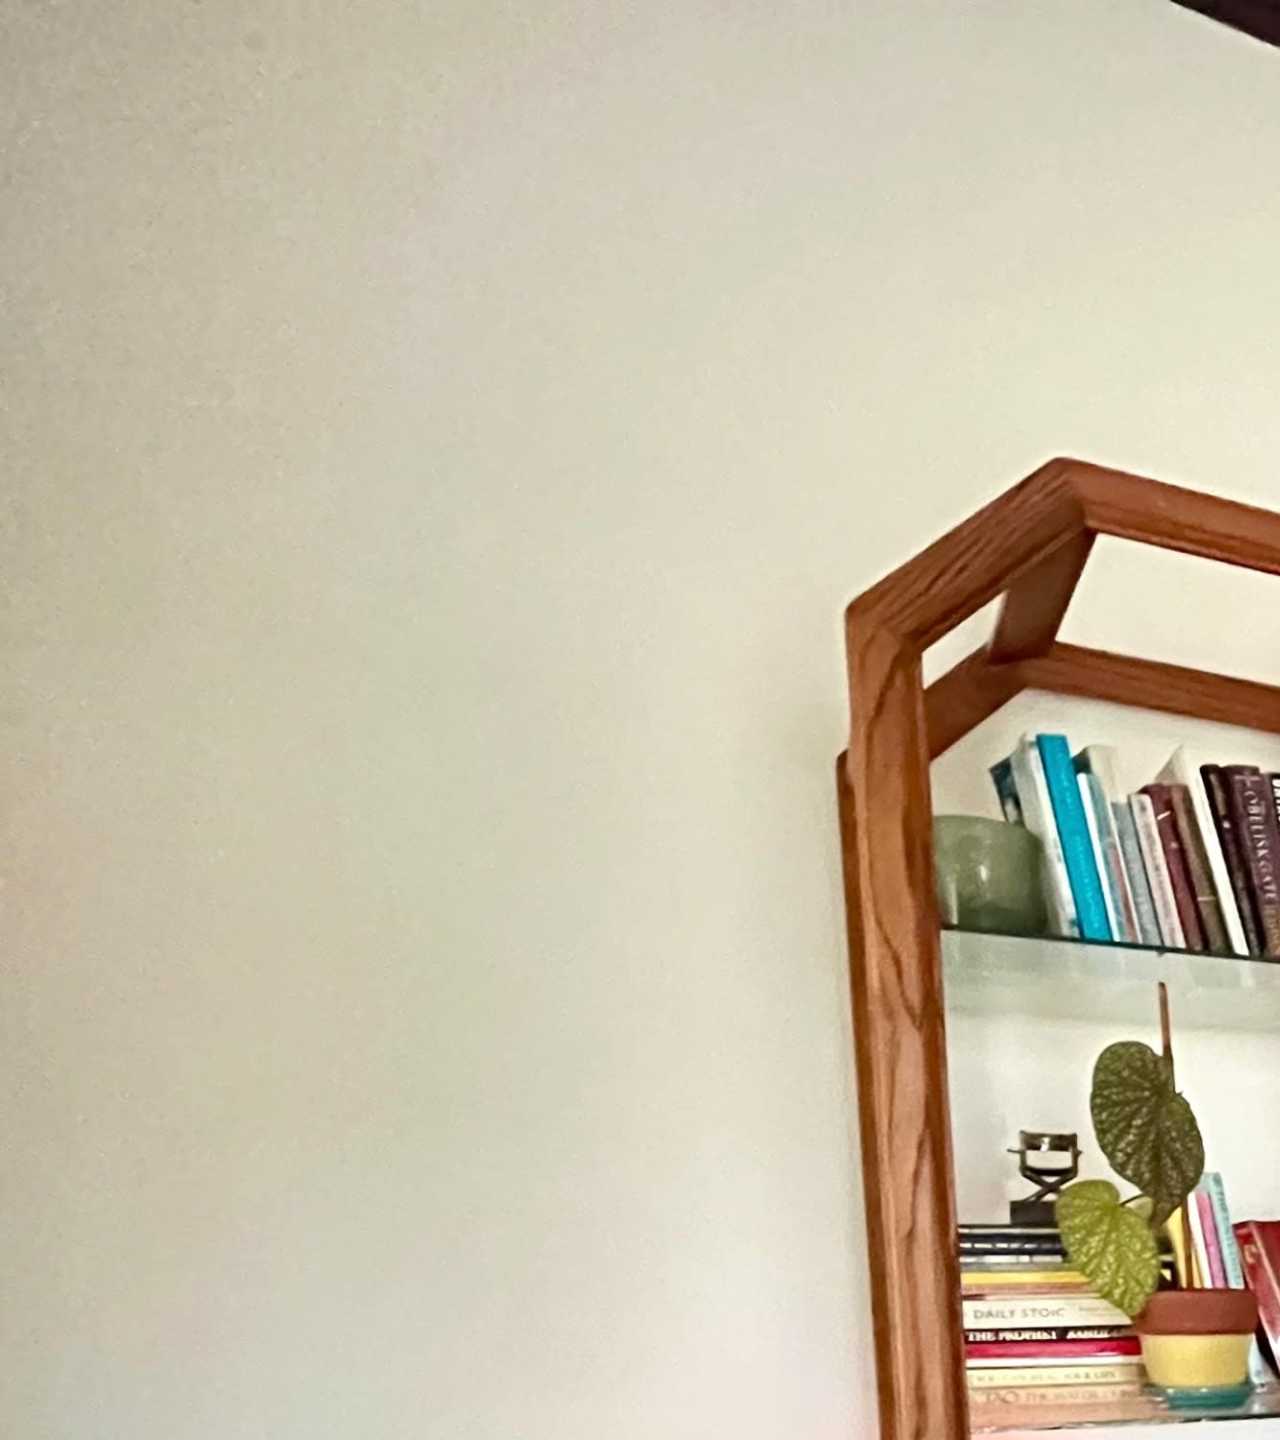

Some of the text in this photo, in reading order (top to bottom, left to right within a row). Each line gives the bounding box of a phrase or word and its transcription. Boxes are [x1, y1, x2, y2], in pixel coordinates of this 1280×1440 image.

[973, 1308, 1015, 1321] DAILY
[1022, 1306, 1066, 1319] STOIC
[967, 1331, 997, 1343] THE
